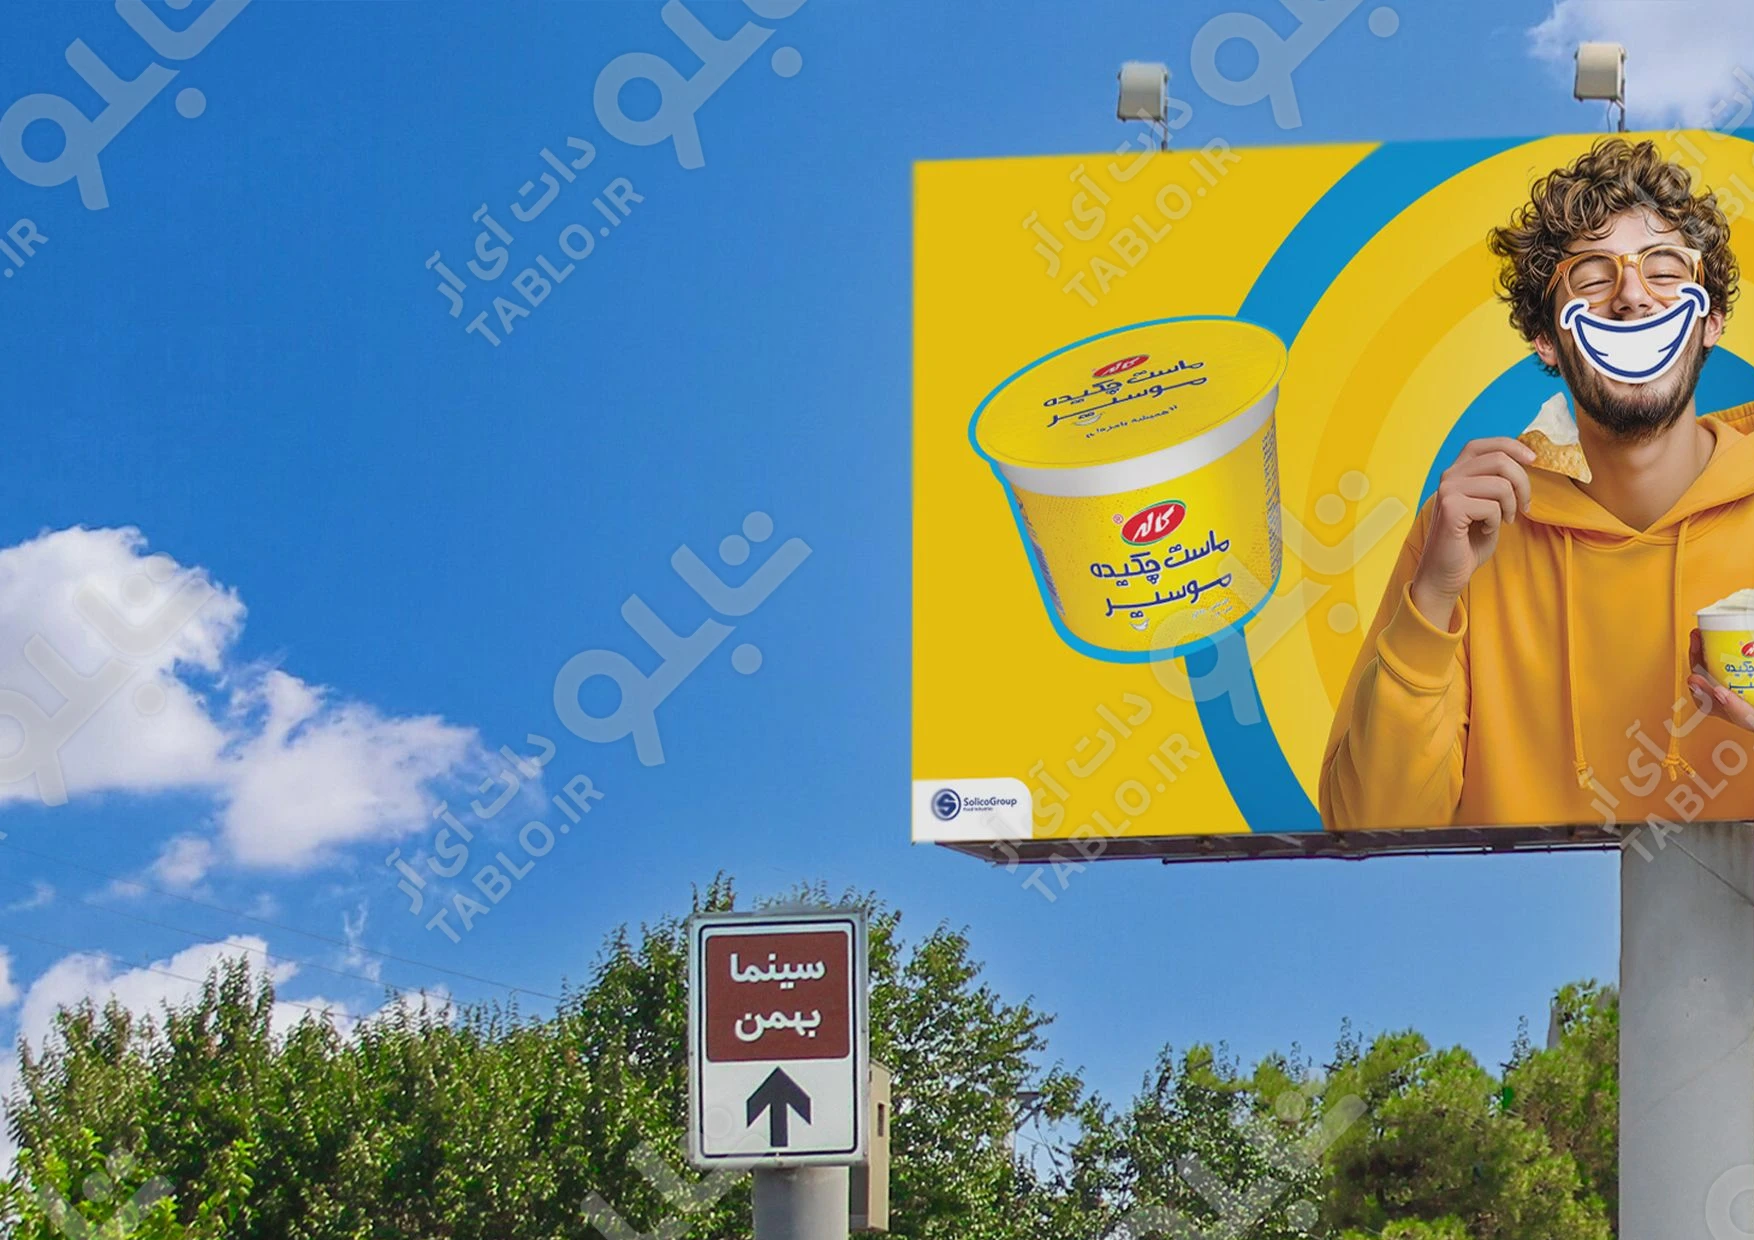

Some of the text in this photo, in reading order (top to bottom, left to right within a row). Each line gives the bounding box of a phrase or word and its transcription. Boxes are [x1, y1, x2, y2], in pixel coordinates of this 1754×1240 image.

[1043, 359, 1205, 407] ماست چکیده
[1046, 376, 1208, 428] موسیر
[1089, 530, 1230, 587] ماست چکیده
[1105, 573, 1232, 618] موسیر
[729, 952, 826, 990] سینما
[734, 1006, 822, 1042] بهمن
